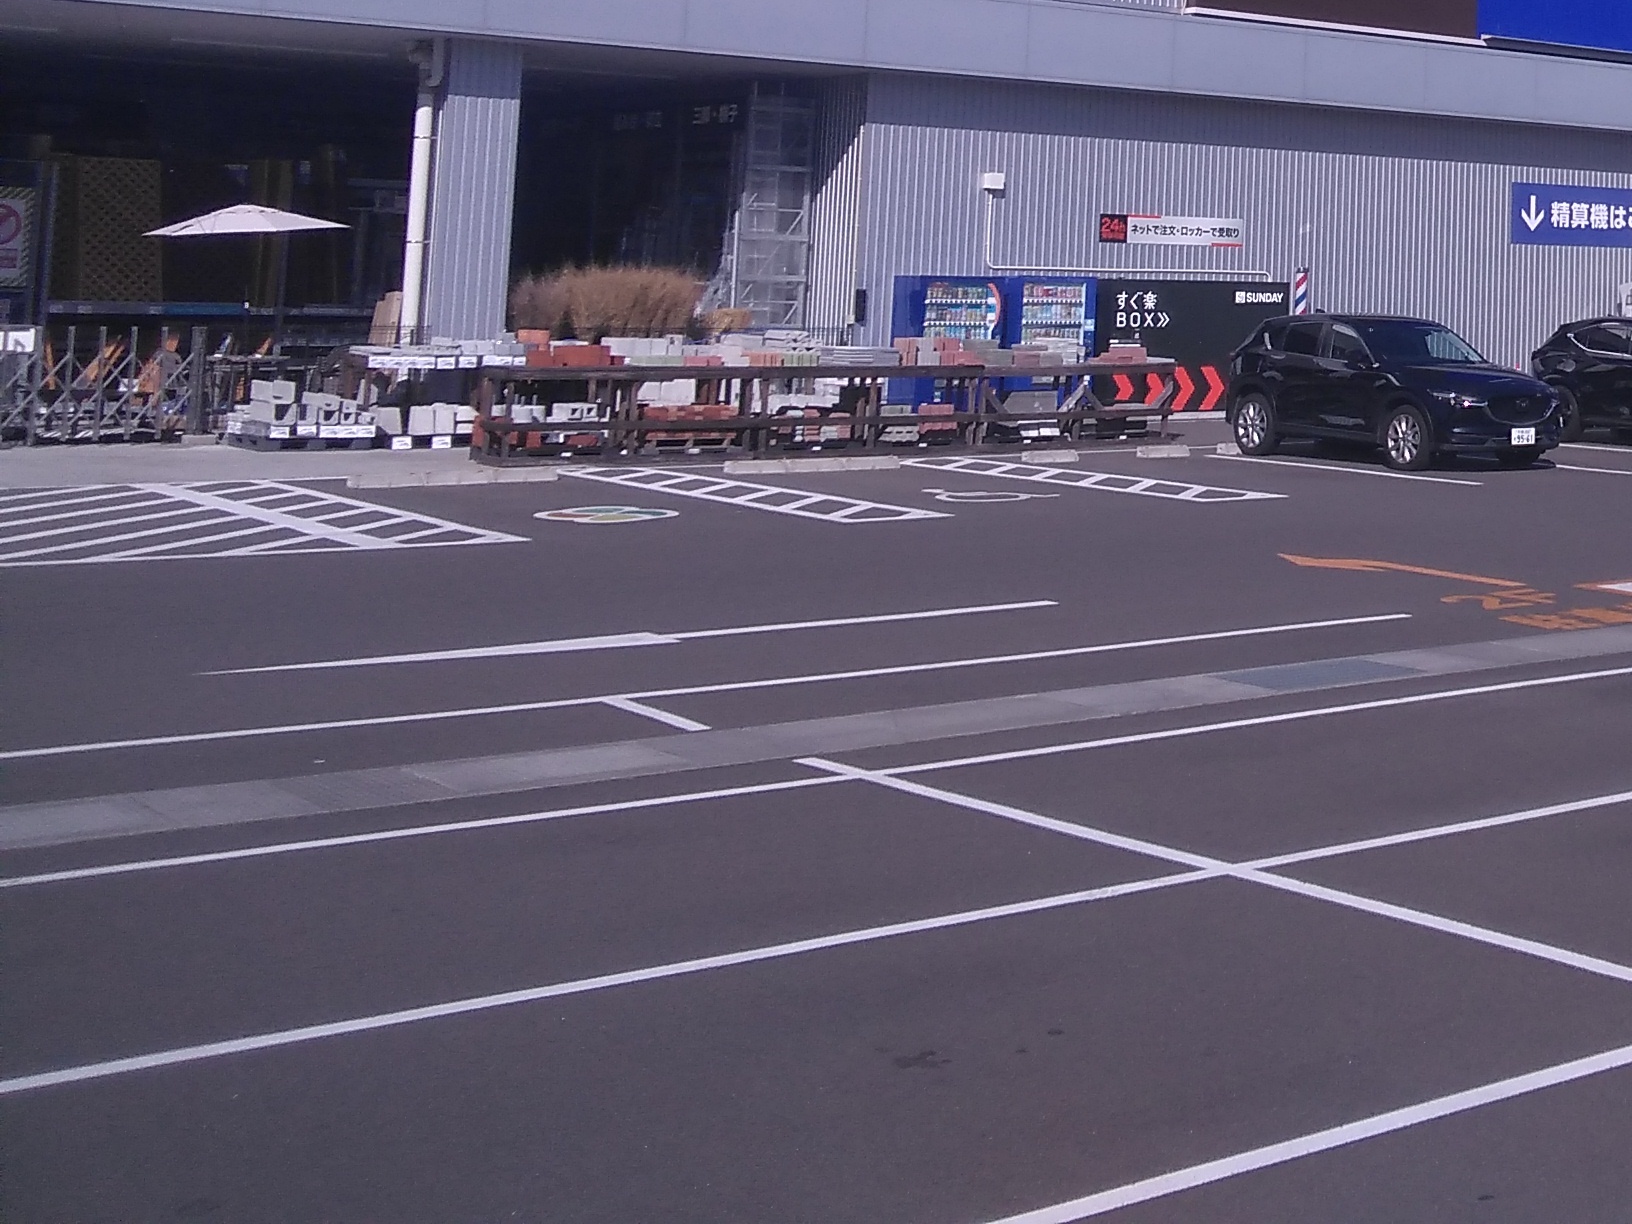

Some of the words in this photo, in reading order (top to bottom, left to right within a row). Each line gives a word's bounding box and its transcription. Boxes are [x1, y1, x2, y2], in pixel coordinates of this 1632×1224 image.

[1130, 223, 1240, 238] ネットで注文・ロッカーで受取り
[1116, 290, 1158, 310] すぐ楽
[1246, 292, 1284, 303] SUNDAY
[1116, 312, 1155, 327] BOX
